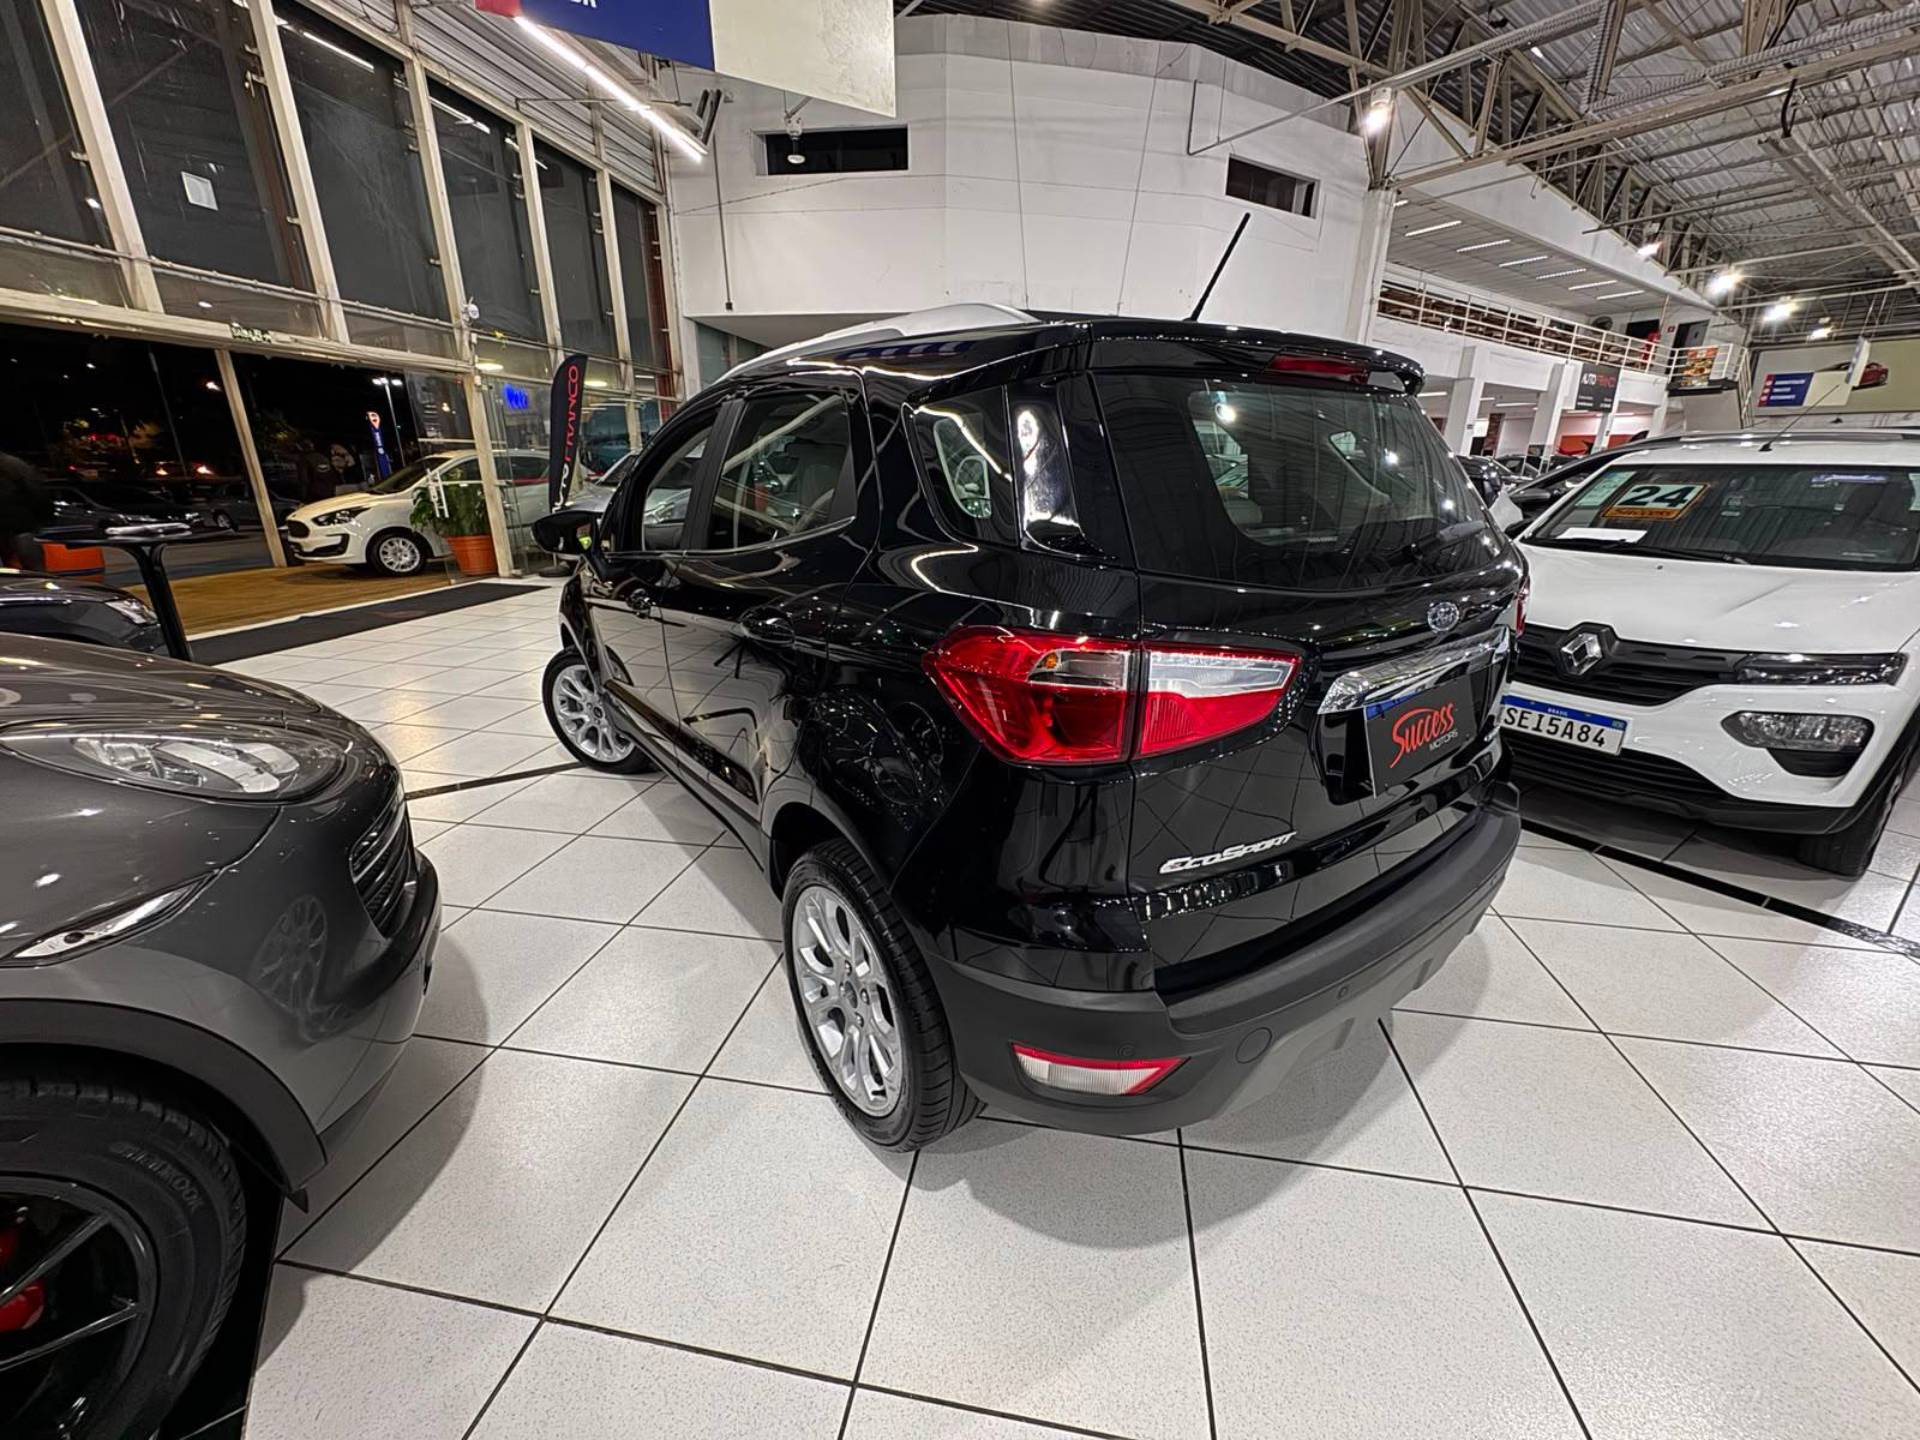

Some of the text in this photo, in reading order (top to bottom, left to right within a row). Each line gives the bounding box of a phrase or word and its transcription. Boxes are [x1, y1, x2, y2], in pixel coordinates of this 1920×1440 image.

[1617, 485, 1696, 508] 24
[1389, 702, 1455, 769] Success
[1429, 731, 1458, 750] MOTORS
[1503, 706, 1606, 748] SEI5A84
